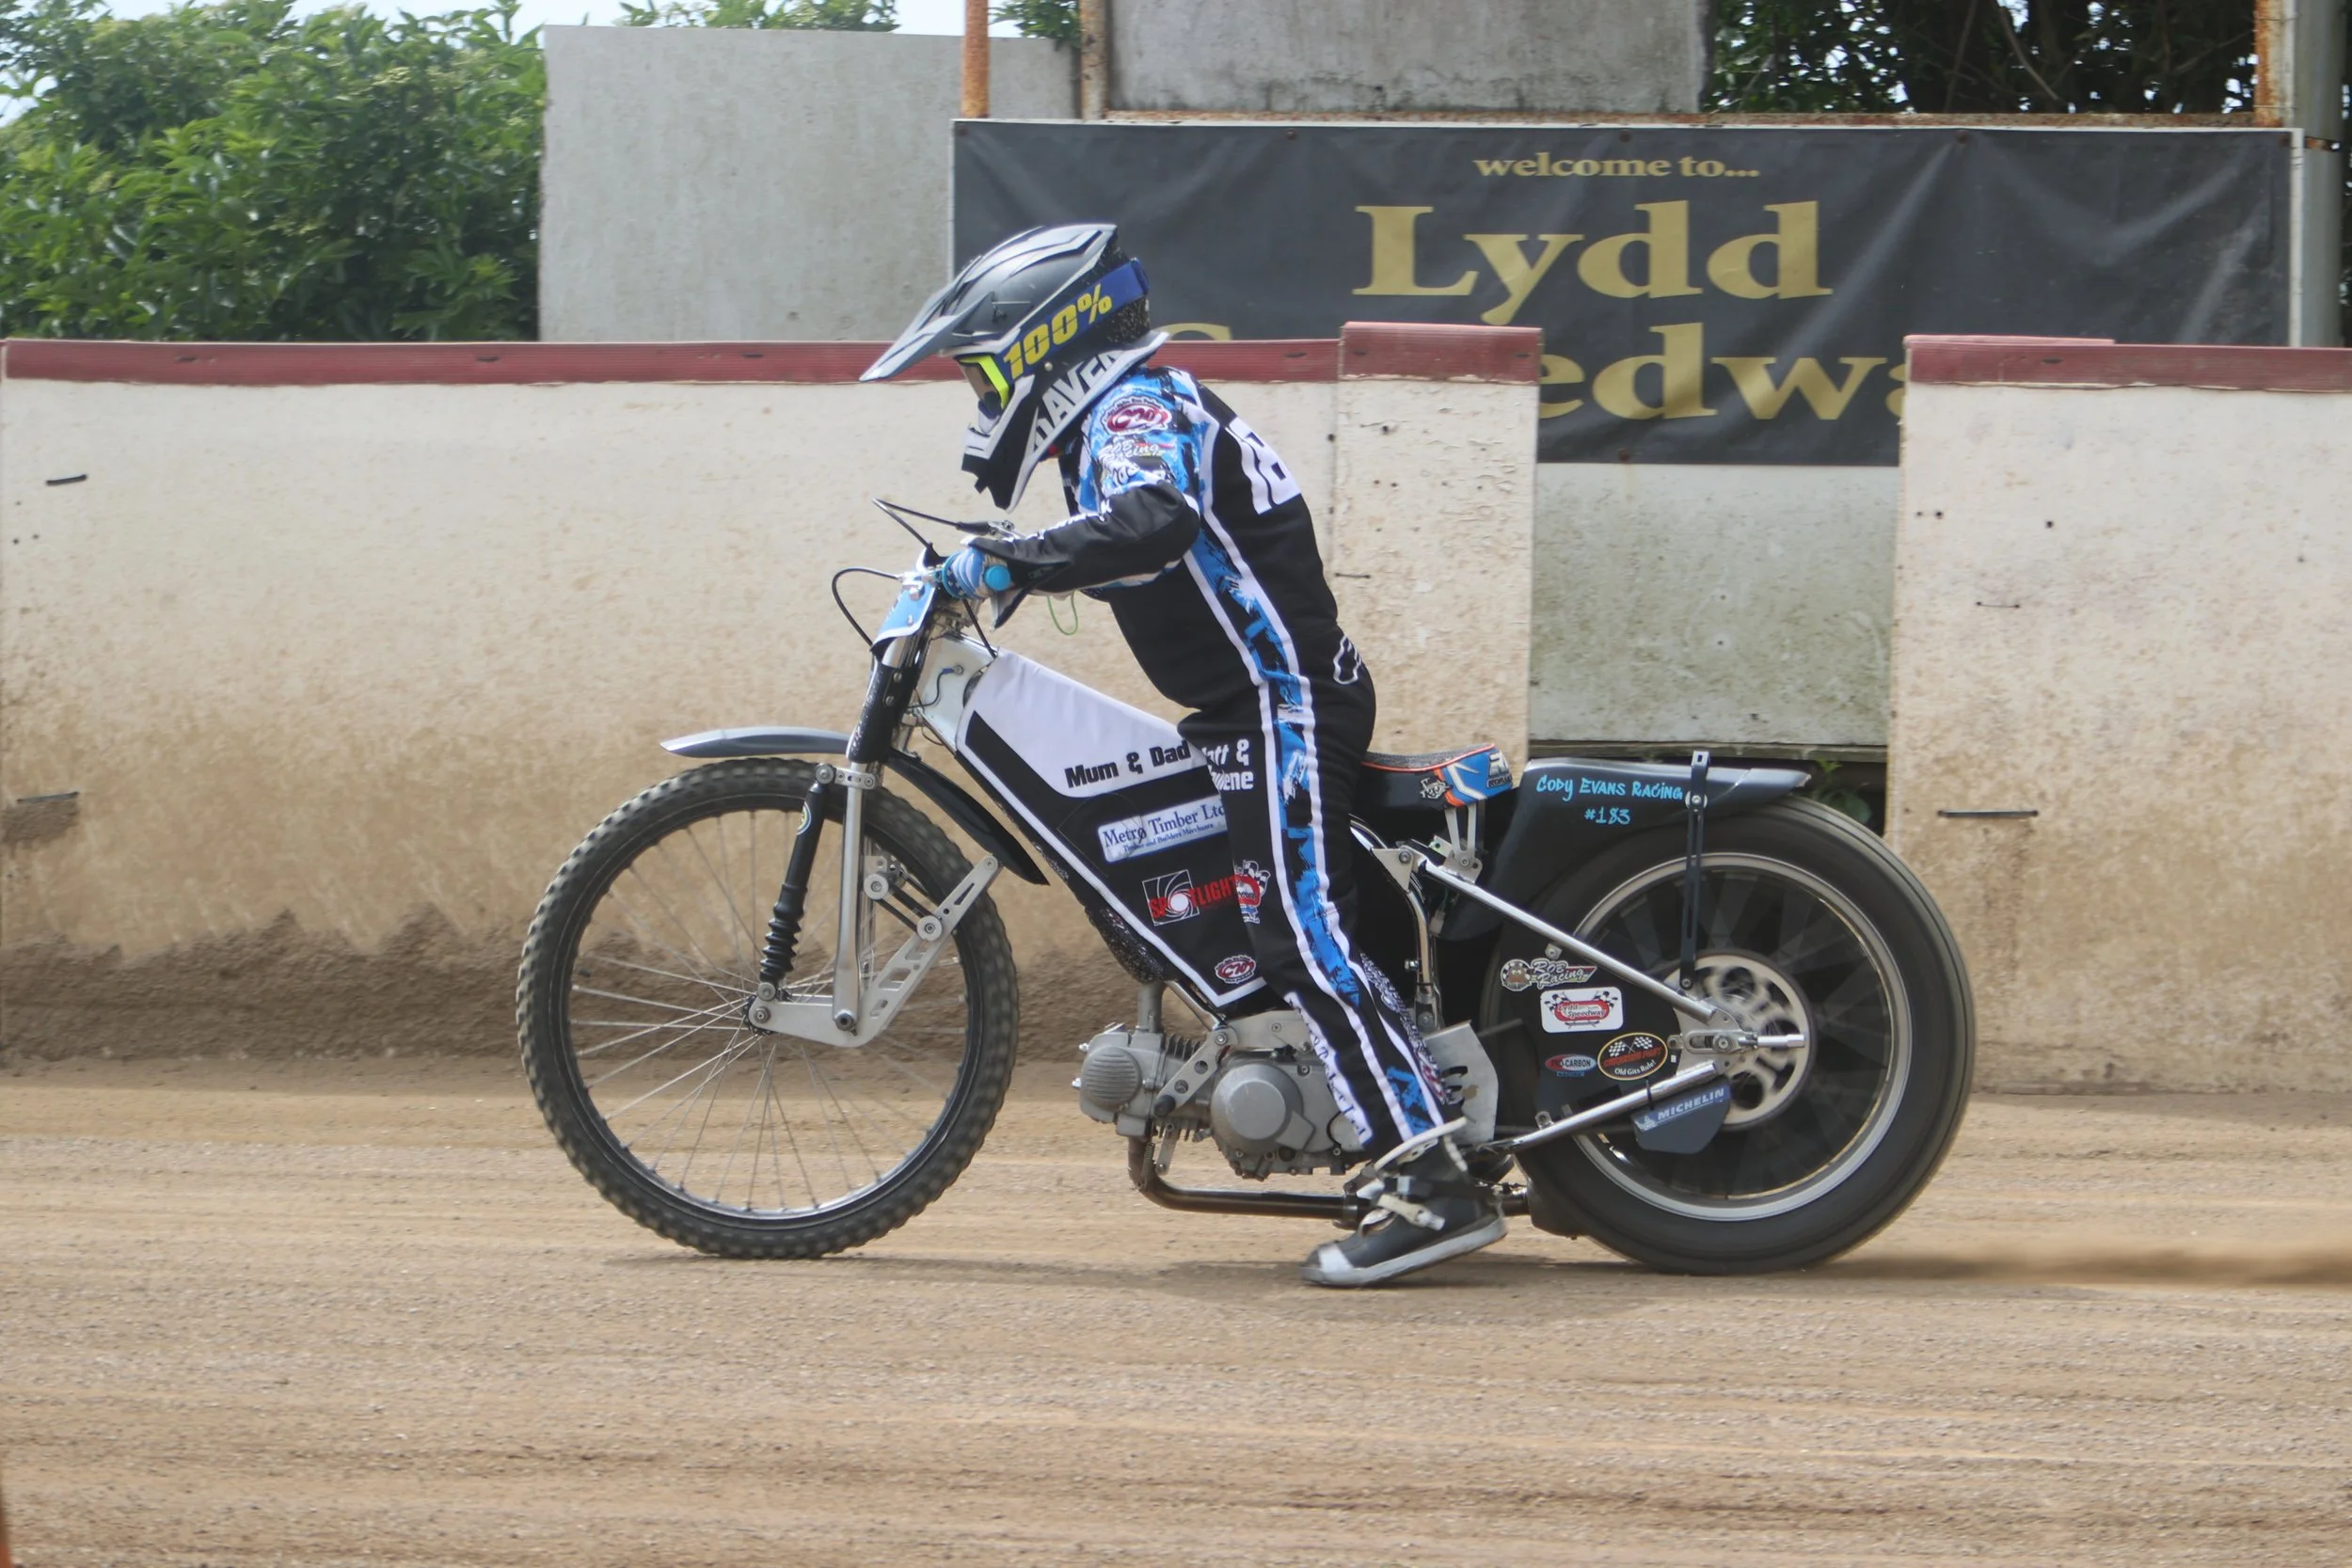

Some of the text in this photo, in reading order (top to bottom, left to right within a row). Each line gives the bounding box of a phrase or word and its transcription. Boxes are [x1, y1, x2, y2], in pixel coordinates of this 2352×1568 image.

[1472, 151, 1760, 178] welcome to...
[1351, 199, 1834, 325] Lydd
[1003, 283, 1113, 380] 100%
[1064, 739, 1192, 788] Mum & Dad
[1235, 738, 1249, 767] &
[1103, 827, 1147, 847] Metro
[1148, 811, 1199, 835] Timber
[1584, 807, 1631, 825] #183
[1613, 1068, 1627, 1076] Old
[1657, 1087, 1725, 1121] MICHELIN
